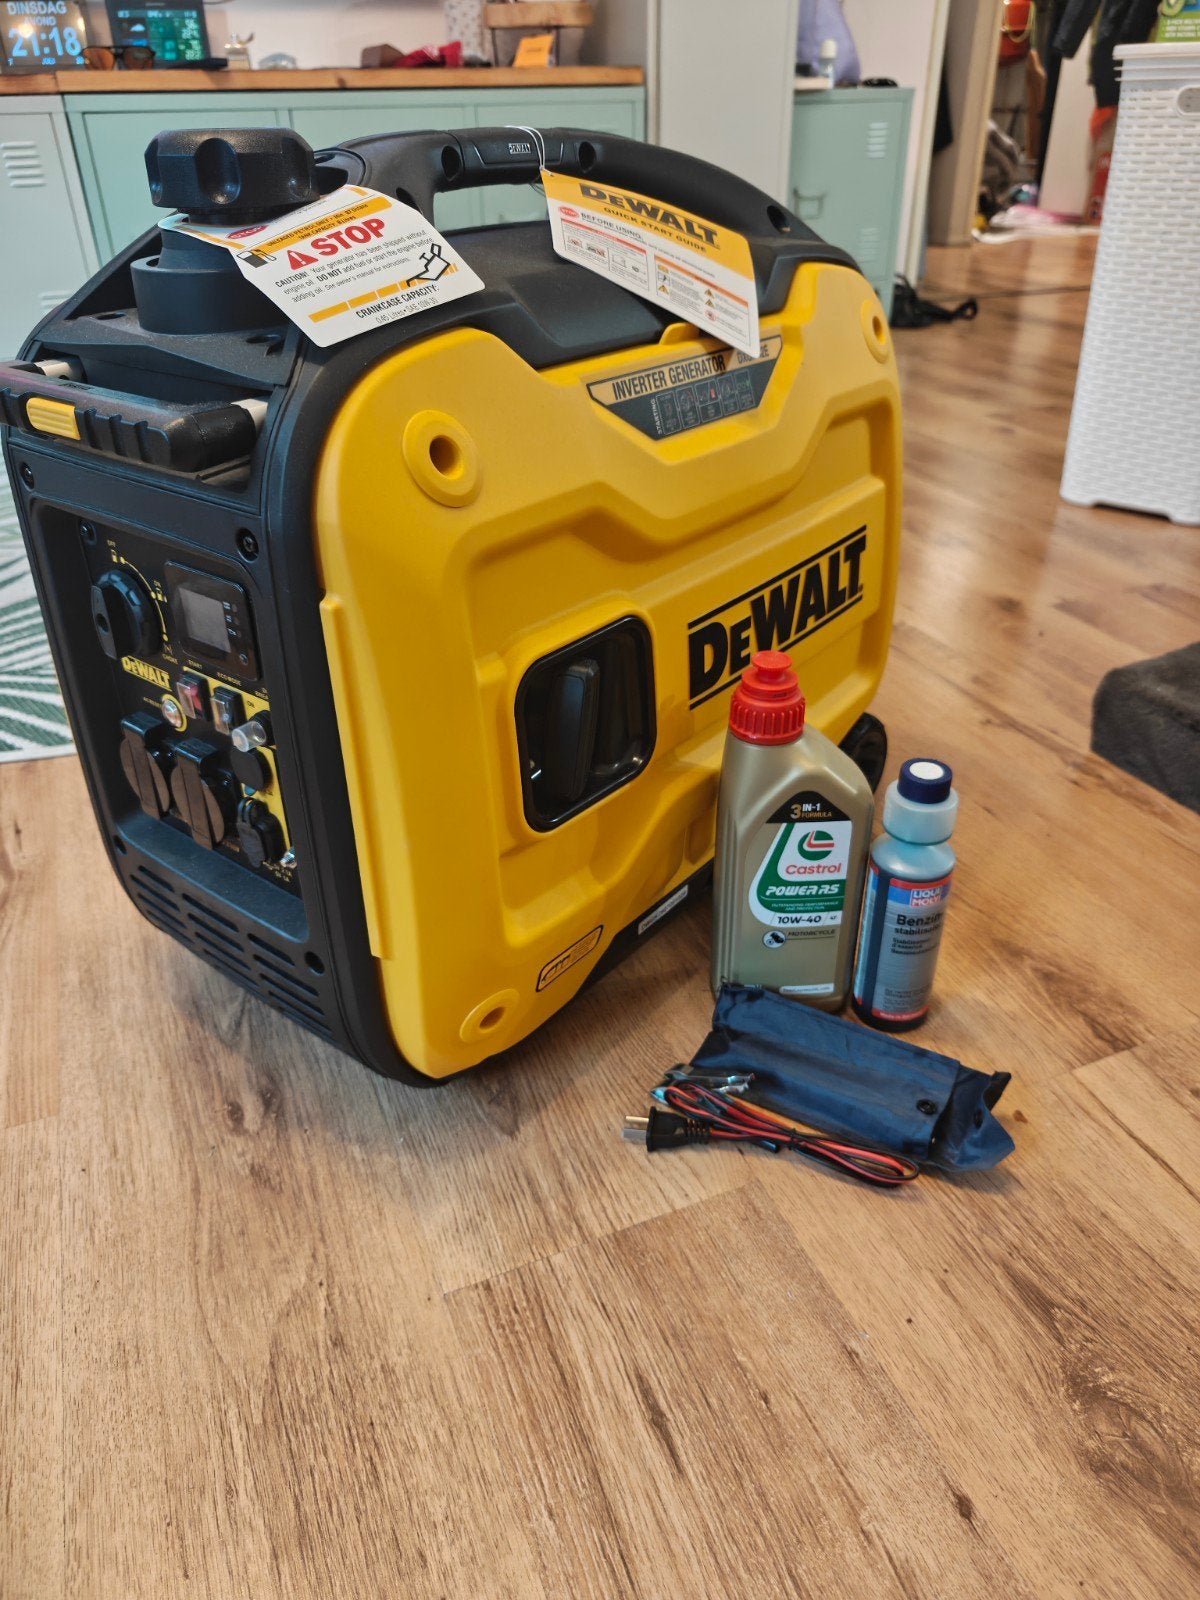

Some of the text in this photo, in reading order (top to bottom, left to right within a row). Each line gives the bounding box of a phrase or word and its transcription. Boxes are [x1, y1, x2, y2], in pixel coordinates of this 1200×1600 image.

[7, 1, 67, 15] DINSDAG
[8, 27, 81, 57] 21:18
[310, 218, 386, 257] STOP
[604, 206, 707, 251] QUICK START GUIDE
[283, 283, 306, 295] engine
[316, 273, 329, 282] DO
[328, 268, 342, 278] NOT
[342, 264, 355, 273] add
[353, 260, 367, 269] fuel
[397, 243, 415, 255] engine
[415, 237, 433, 248] before
[310, 265, 326, 274] Your
[327, 253, 355, 269] generator
[366, 244, 383, 254] been
[383, 236, 406, 248] shipped
[405, 229, 427, 241] without
[291, 290, 316, 303] adding
[324, 282, 336, 291] See
[356, 268, 376, 279] manual
[355, 284, 438, 319] CRANKCASE CAPACITY:
[612, 370, 667, 401] INVERTER
[668, 354, 726, 386] GENERATOR
[651, 398, 663, 435] STARTING
[688, 535, 867, 701] DEWALT
[121, 657, 171, 687] DEWALT
[790, 803, 821, 819] 3 IN-1
[801, 811, 832, 819] FORMULA
[785, 863, 842, 875] Castrol
[765, 884, 840, 897] POWER RS
[911, 895, 940, 907] MOLY
[777, 915, 822, 924] 10W-40
[787, 928, 836, 938] MOTORCYCLE
